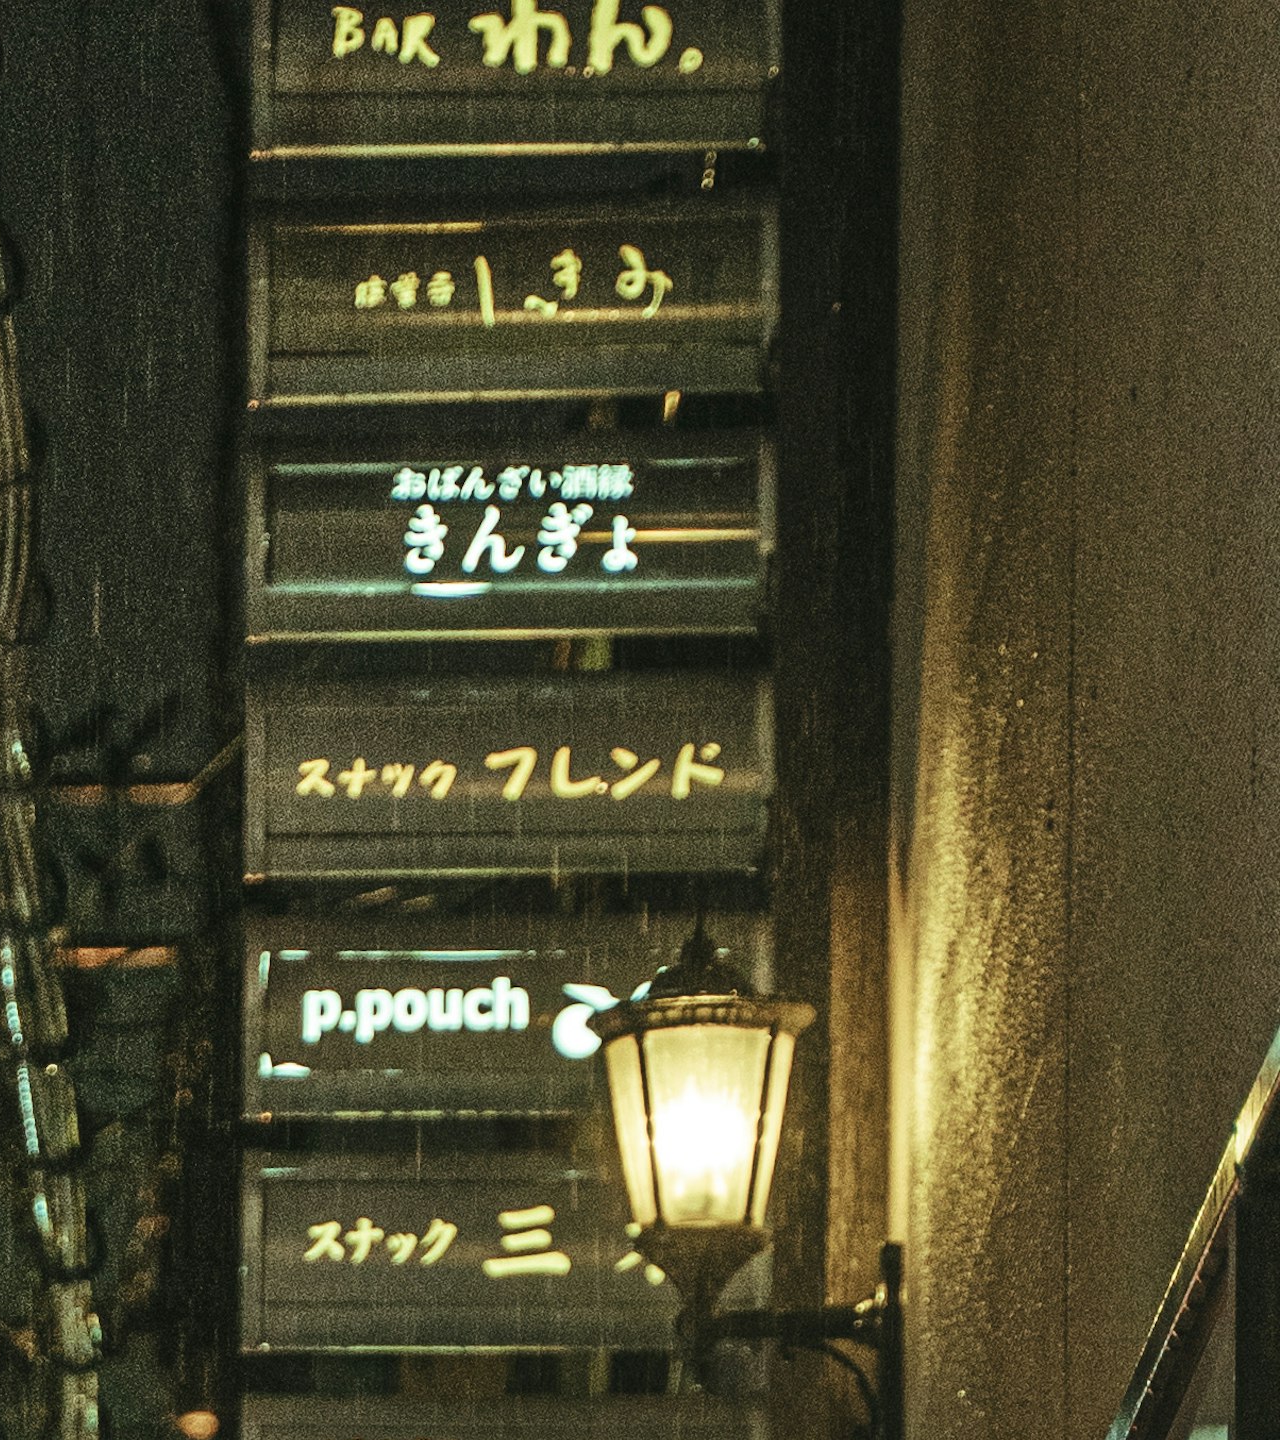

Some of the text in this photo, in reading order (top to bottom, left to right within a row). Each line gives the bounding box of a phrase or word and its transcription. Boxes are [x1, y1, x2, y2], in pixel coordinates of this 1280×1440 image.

[332, 7, 440, 68] BAR
[403, 501, 639, 574] きんぎょ
[296, 742, 726, 801] スナック フレンド
[302, 976, 530, 1044] p.pouch
[302, 1216, 459, 1267] スナック
